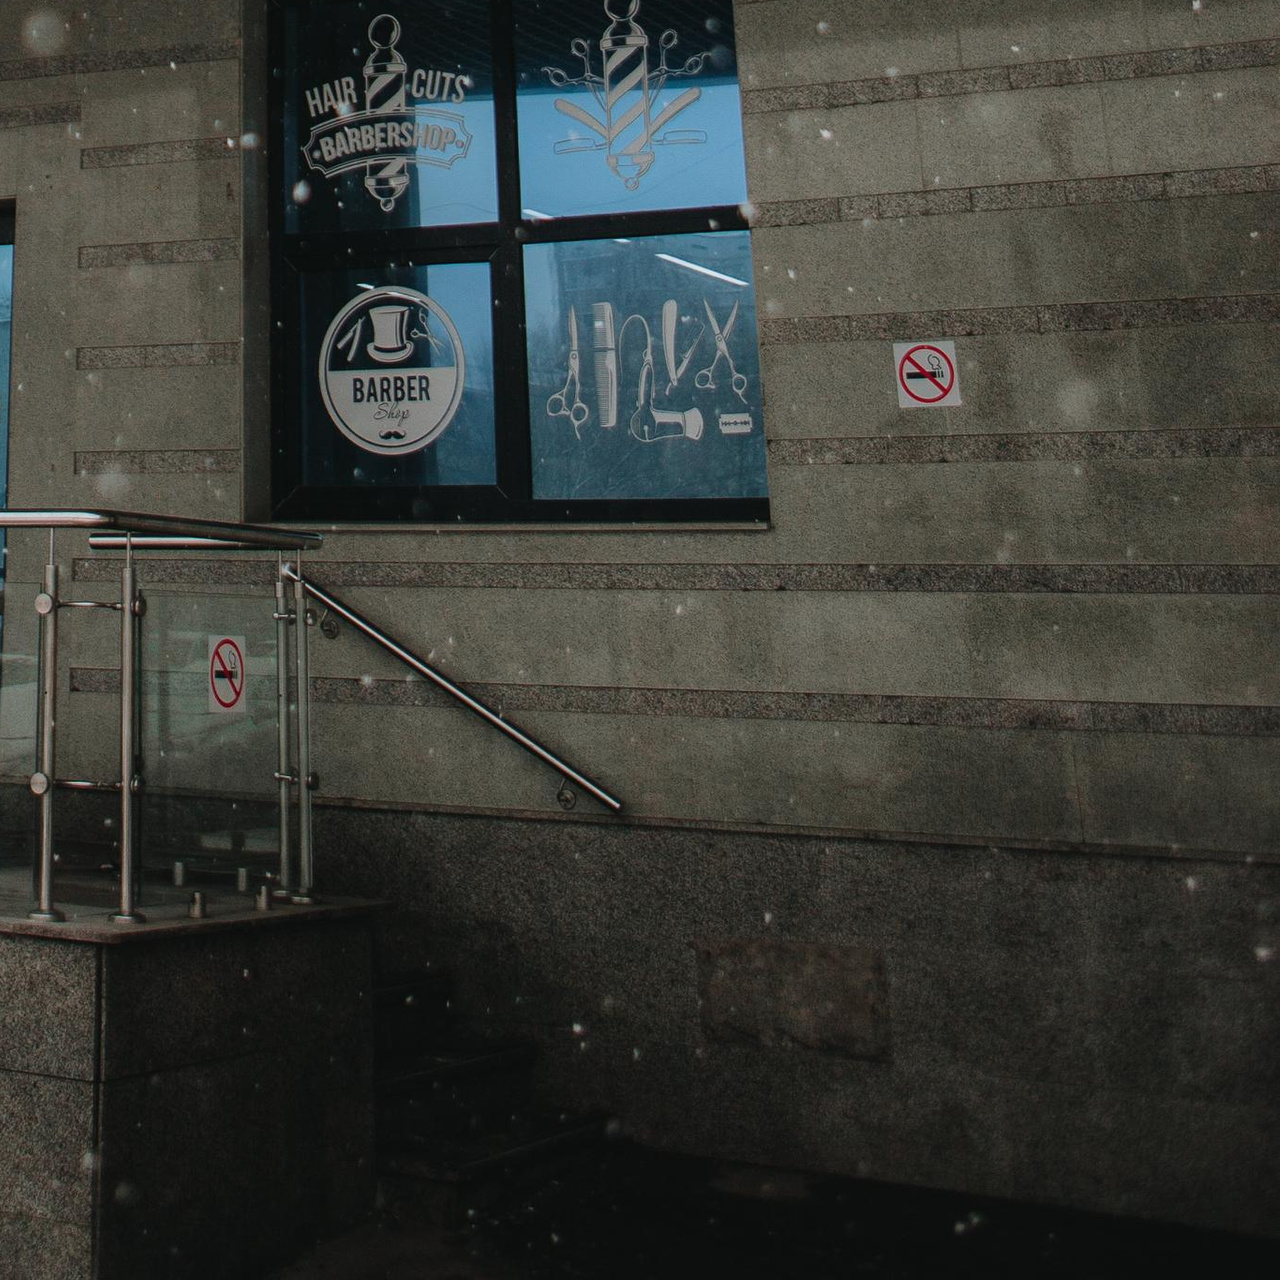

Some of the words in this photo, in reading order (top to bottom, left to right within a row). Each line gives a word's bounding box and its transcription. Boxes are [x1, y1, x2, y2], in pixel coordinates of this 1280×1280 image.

[305, 76, 357, 117] HAIR
[411, 69, 465, 103] CUTS
[319, 121, 456, 162] BARBERSHOP
[352, 375, 430, 402] BARBER
[373, 401, 410, 427] Shop
